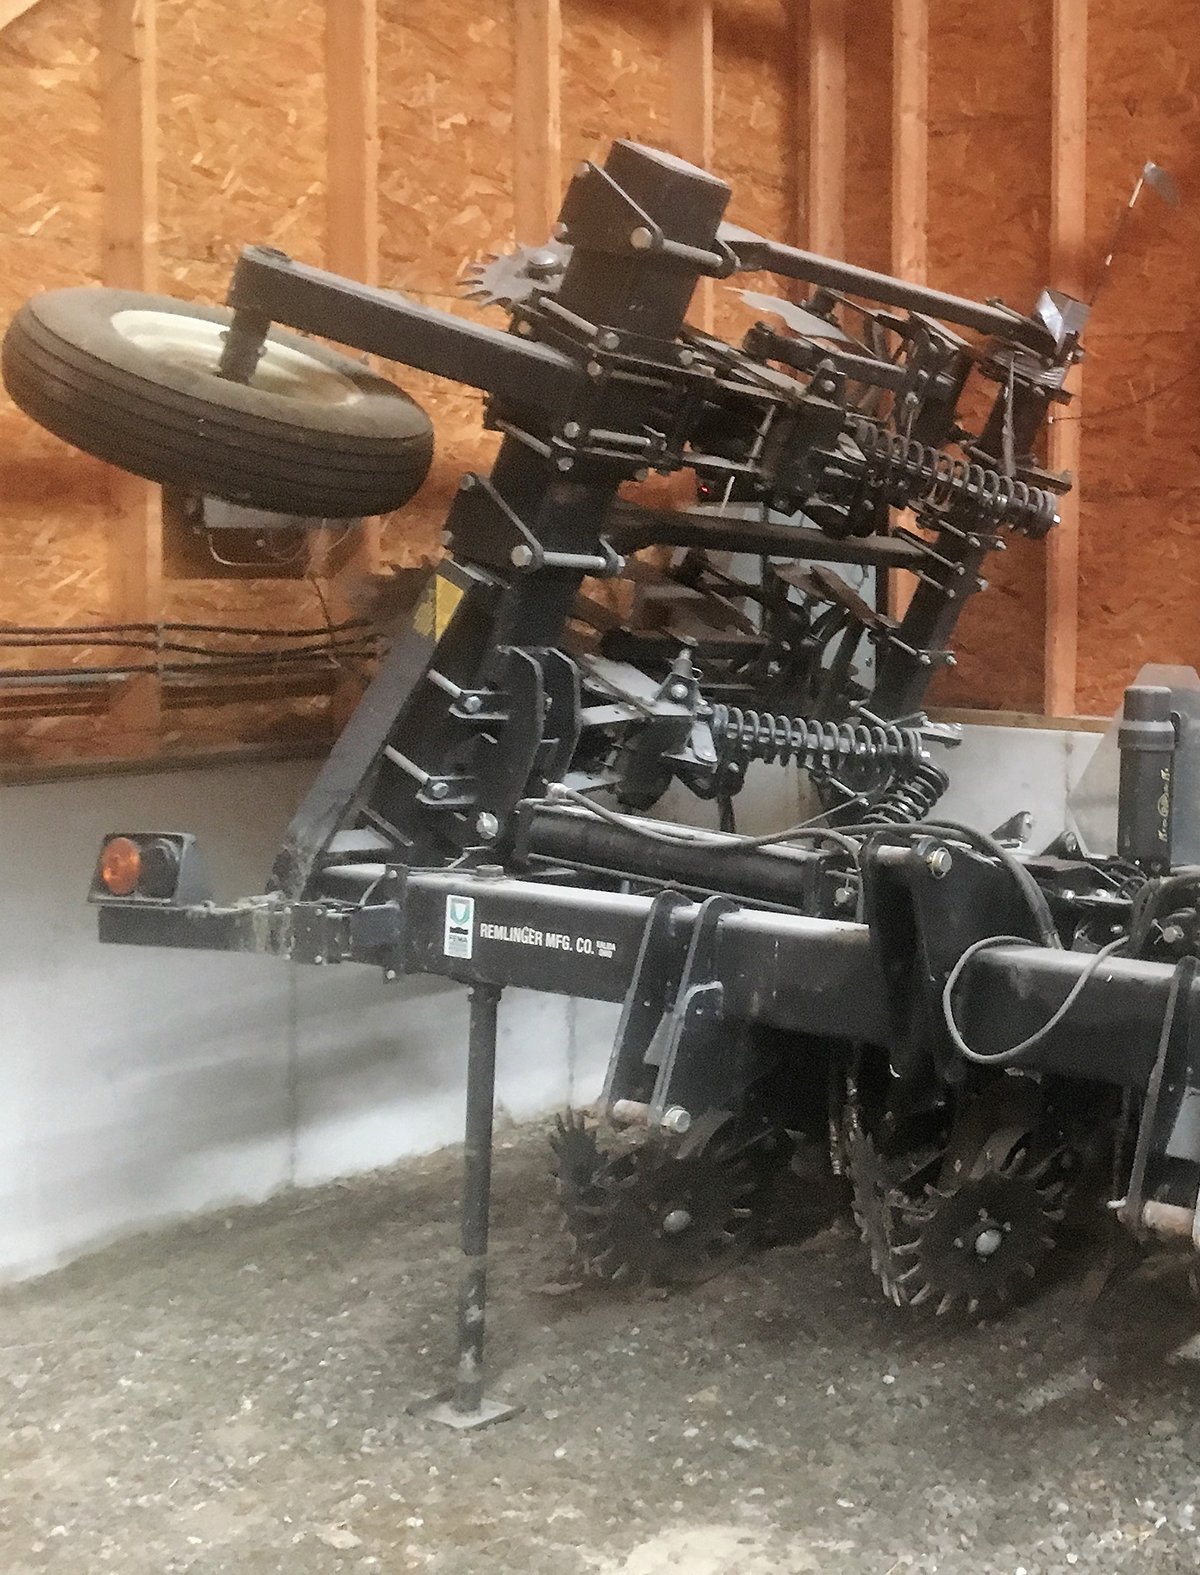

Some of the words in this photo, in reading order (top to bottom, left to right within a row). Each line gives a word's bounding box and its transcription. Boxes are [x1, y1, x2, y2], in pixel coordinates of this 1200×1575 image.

[480, 923, 542, 946] REMLINGER
[546, 933, 572, 951] MFG.
[576, 937, 594, 954] CO.
